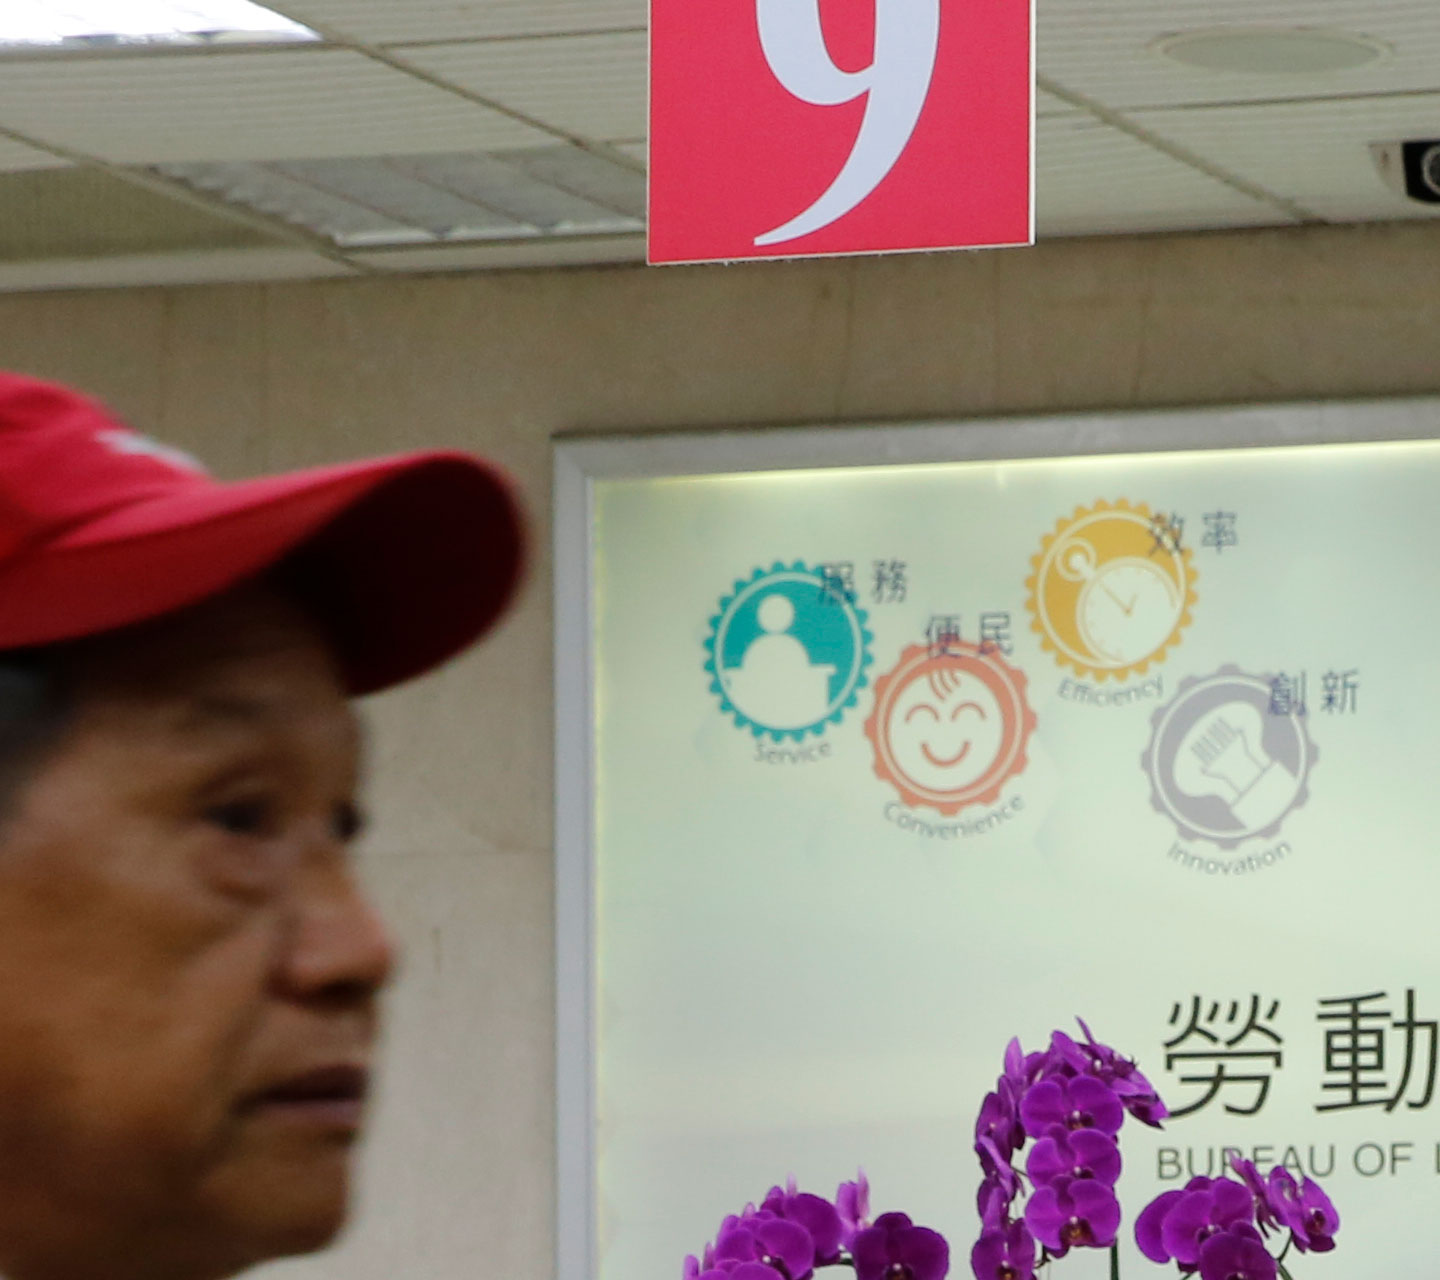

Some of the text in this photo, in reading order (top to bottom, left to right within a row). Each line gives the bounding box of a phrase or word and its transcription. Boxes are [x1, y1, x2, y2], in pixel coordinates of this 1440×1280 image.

[753, 0, 941, 246] 9
[1146, 509, 1240, 556] 效率
[816, 559, 909, 605] 服務
[922, 611, 1015, 660] 便民
[1056, 673, 1165, 707] Efficiency
[1265, 667, 1361, 718] 創新
[753, 739, 833, 765] Service
[882, 793, 1026, 842] Convenience
[1166, 837, 1293, 876] Innovation
[1157, 1144, 1336, 1181] BUREAU
[1353, 1141, 1416, 1177] OF
